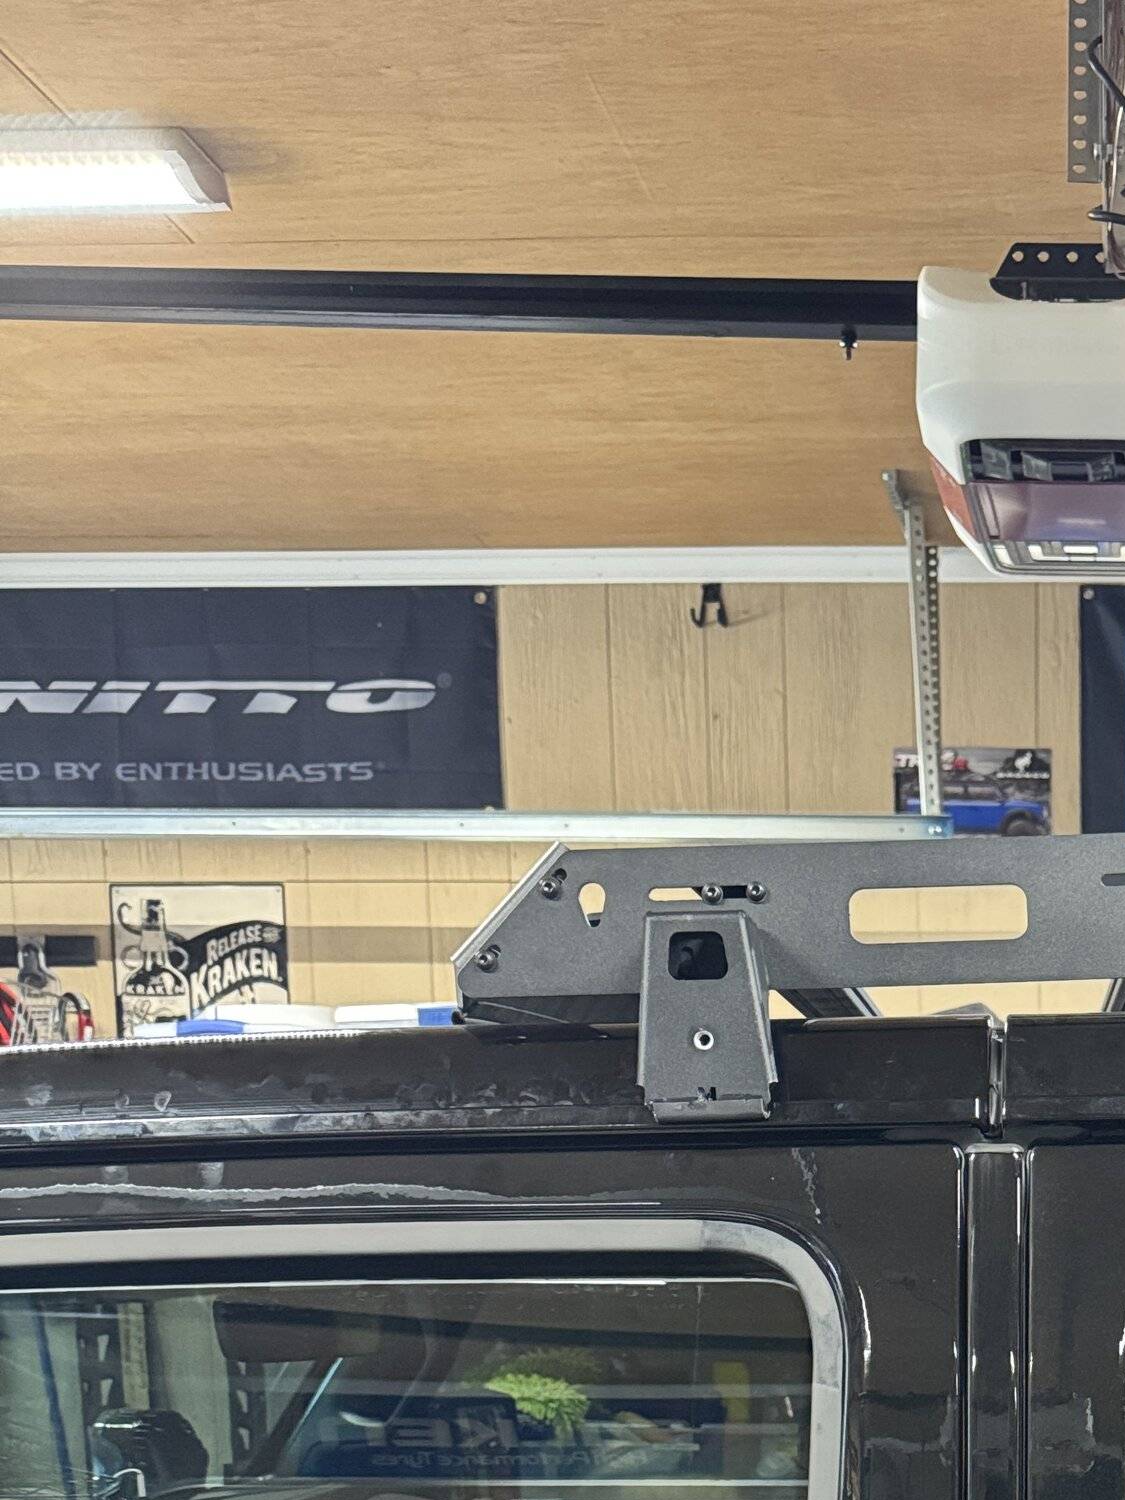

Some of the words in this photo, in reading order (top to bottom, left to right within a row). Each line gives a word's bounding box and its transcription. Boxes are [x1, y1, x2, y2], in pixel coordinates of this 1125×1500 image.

[54, 761, 101, 782] BY
[115, 760, 374, 783] ENTHUSIASTS
[206, 924, 263, 966] RELEASE
